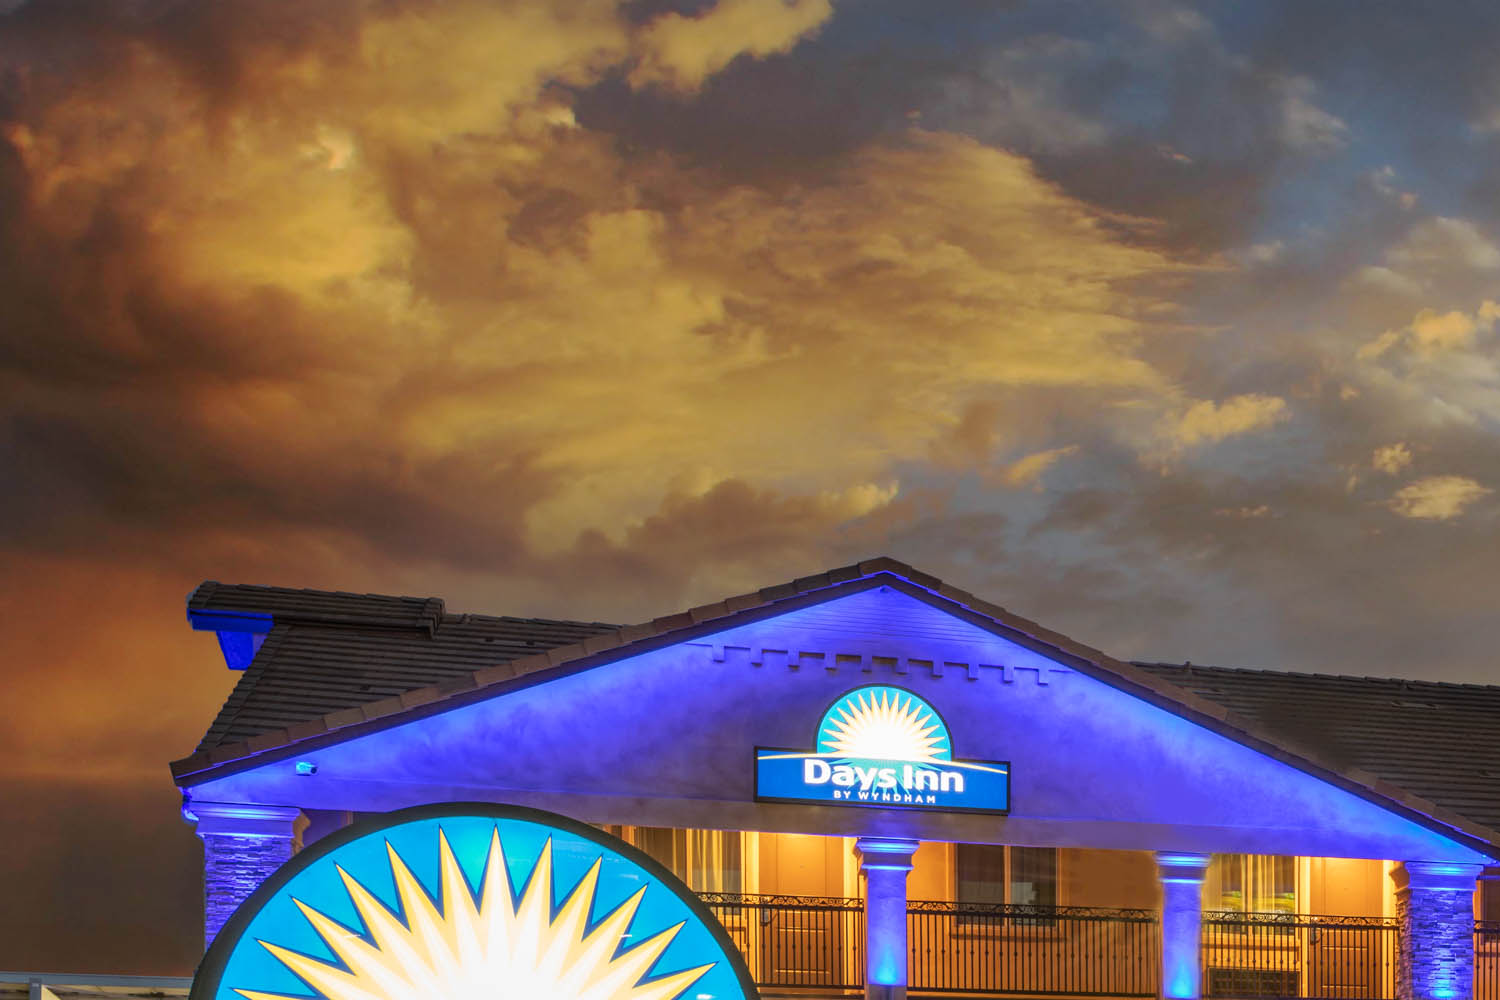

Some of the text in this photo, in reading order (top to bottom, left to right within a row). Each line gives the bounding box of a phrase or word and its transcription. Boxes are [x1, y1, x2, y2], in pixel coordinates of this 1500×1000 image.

[804, 758, 964, 793] Days Inn
[833, 790, 936, 804] BY WYNDHAM
